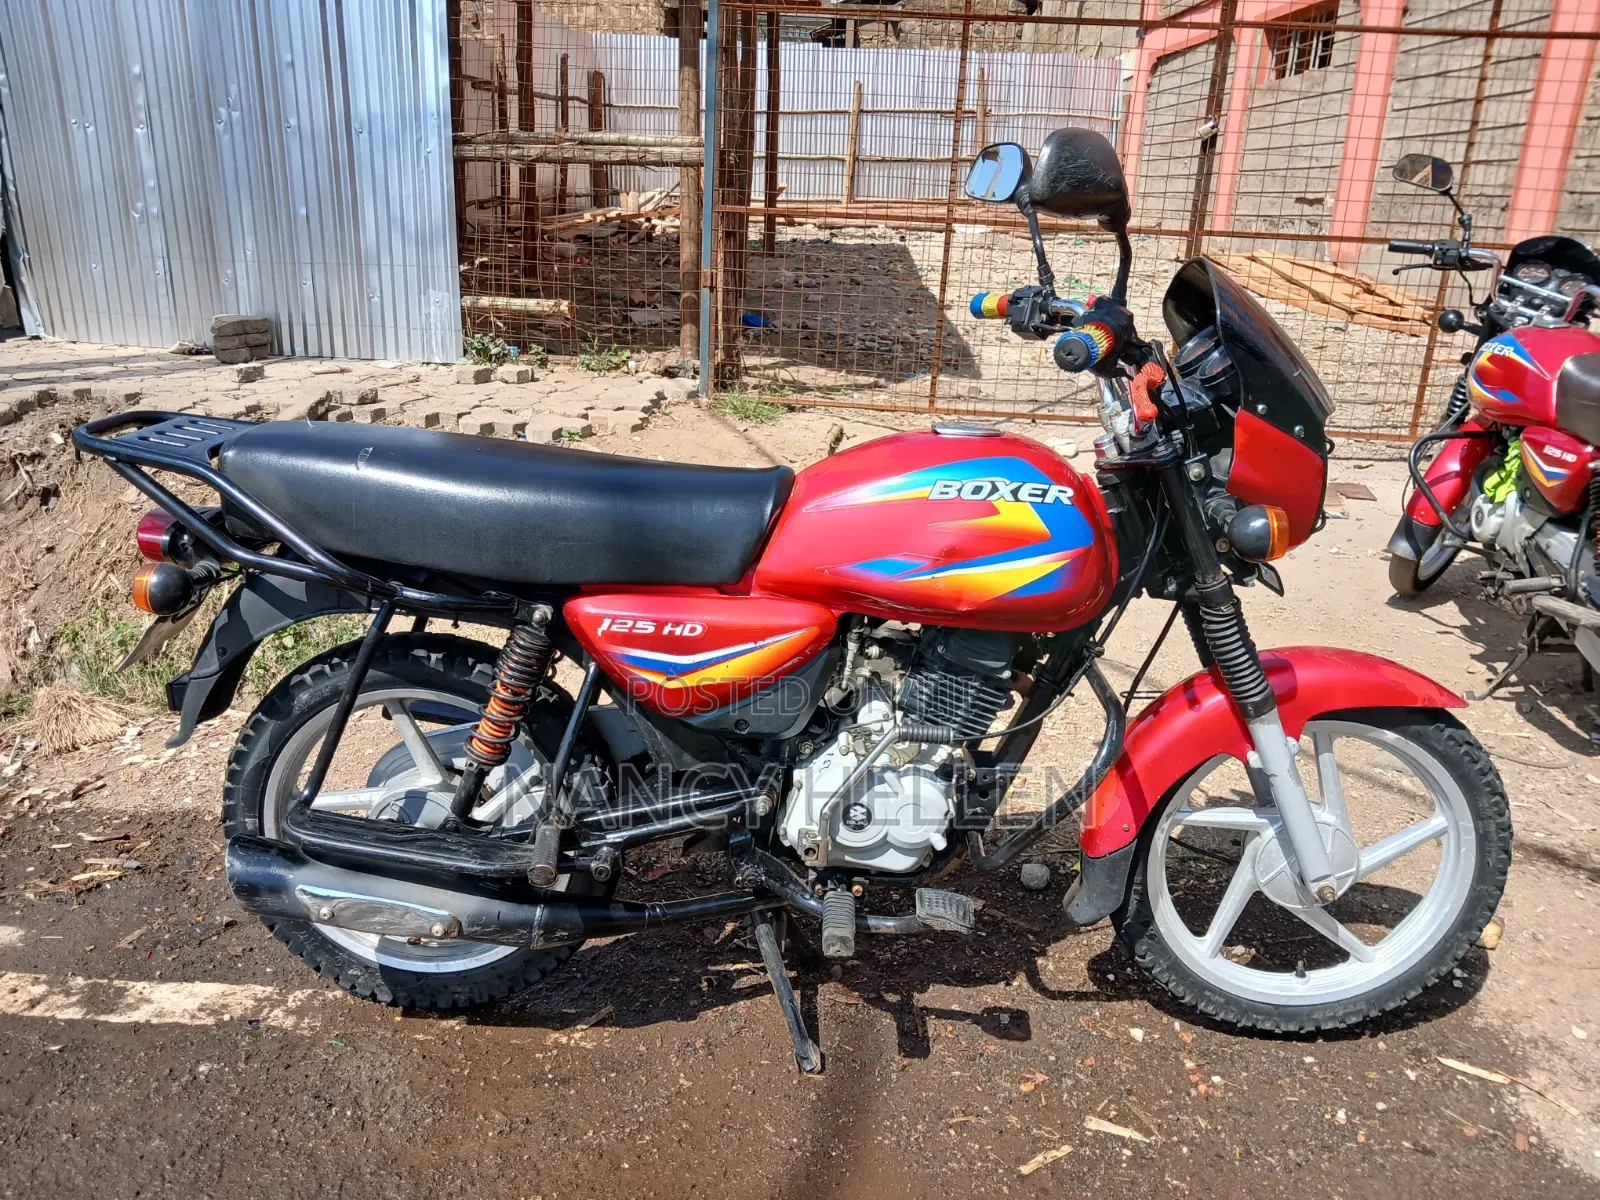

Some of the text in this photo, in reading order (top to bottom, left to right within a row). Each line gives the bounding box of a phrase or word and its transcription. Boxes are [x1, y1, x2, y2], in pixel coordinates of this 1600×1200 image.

[1543, 445, 1577, 463] 125 HD
[927, 479, 1075, 506] BOXER
[597, 618, 703, 637] 125 HD
